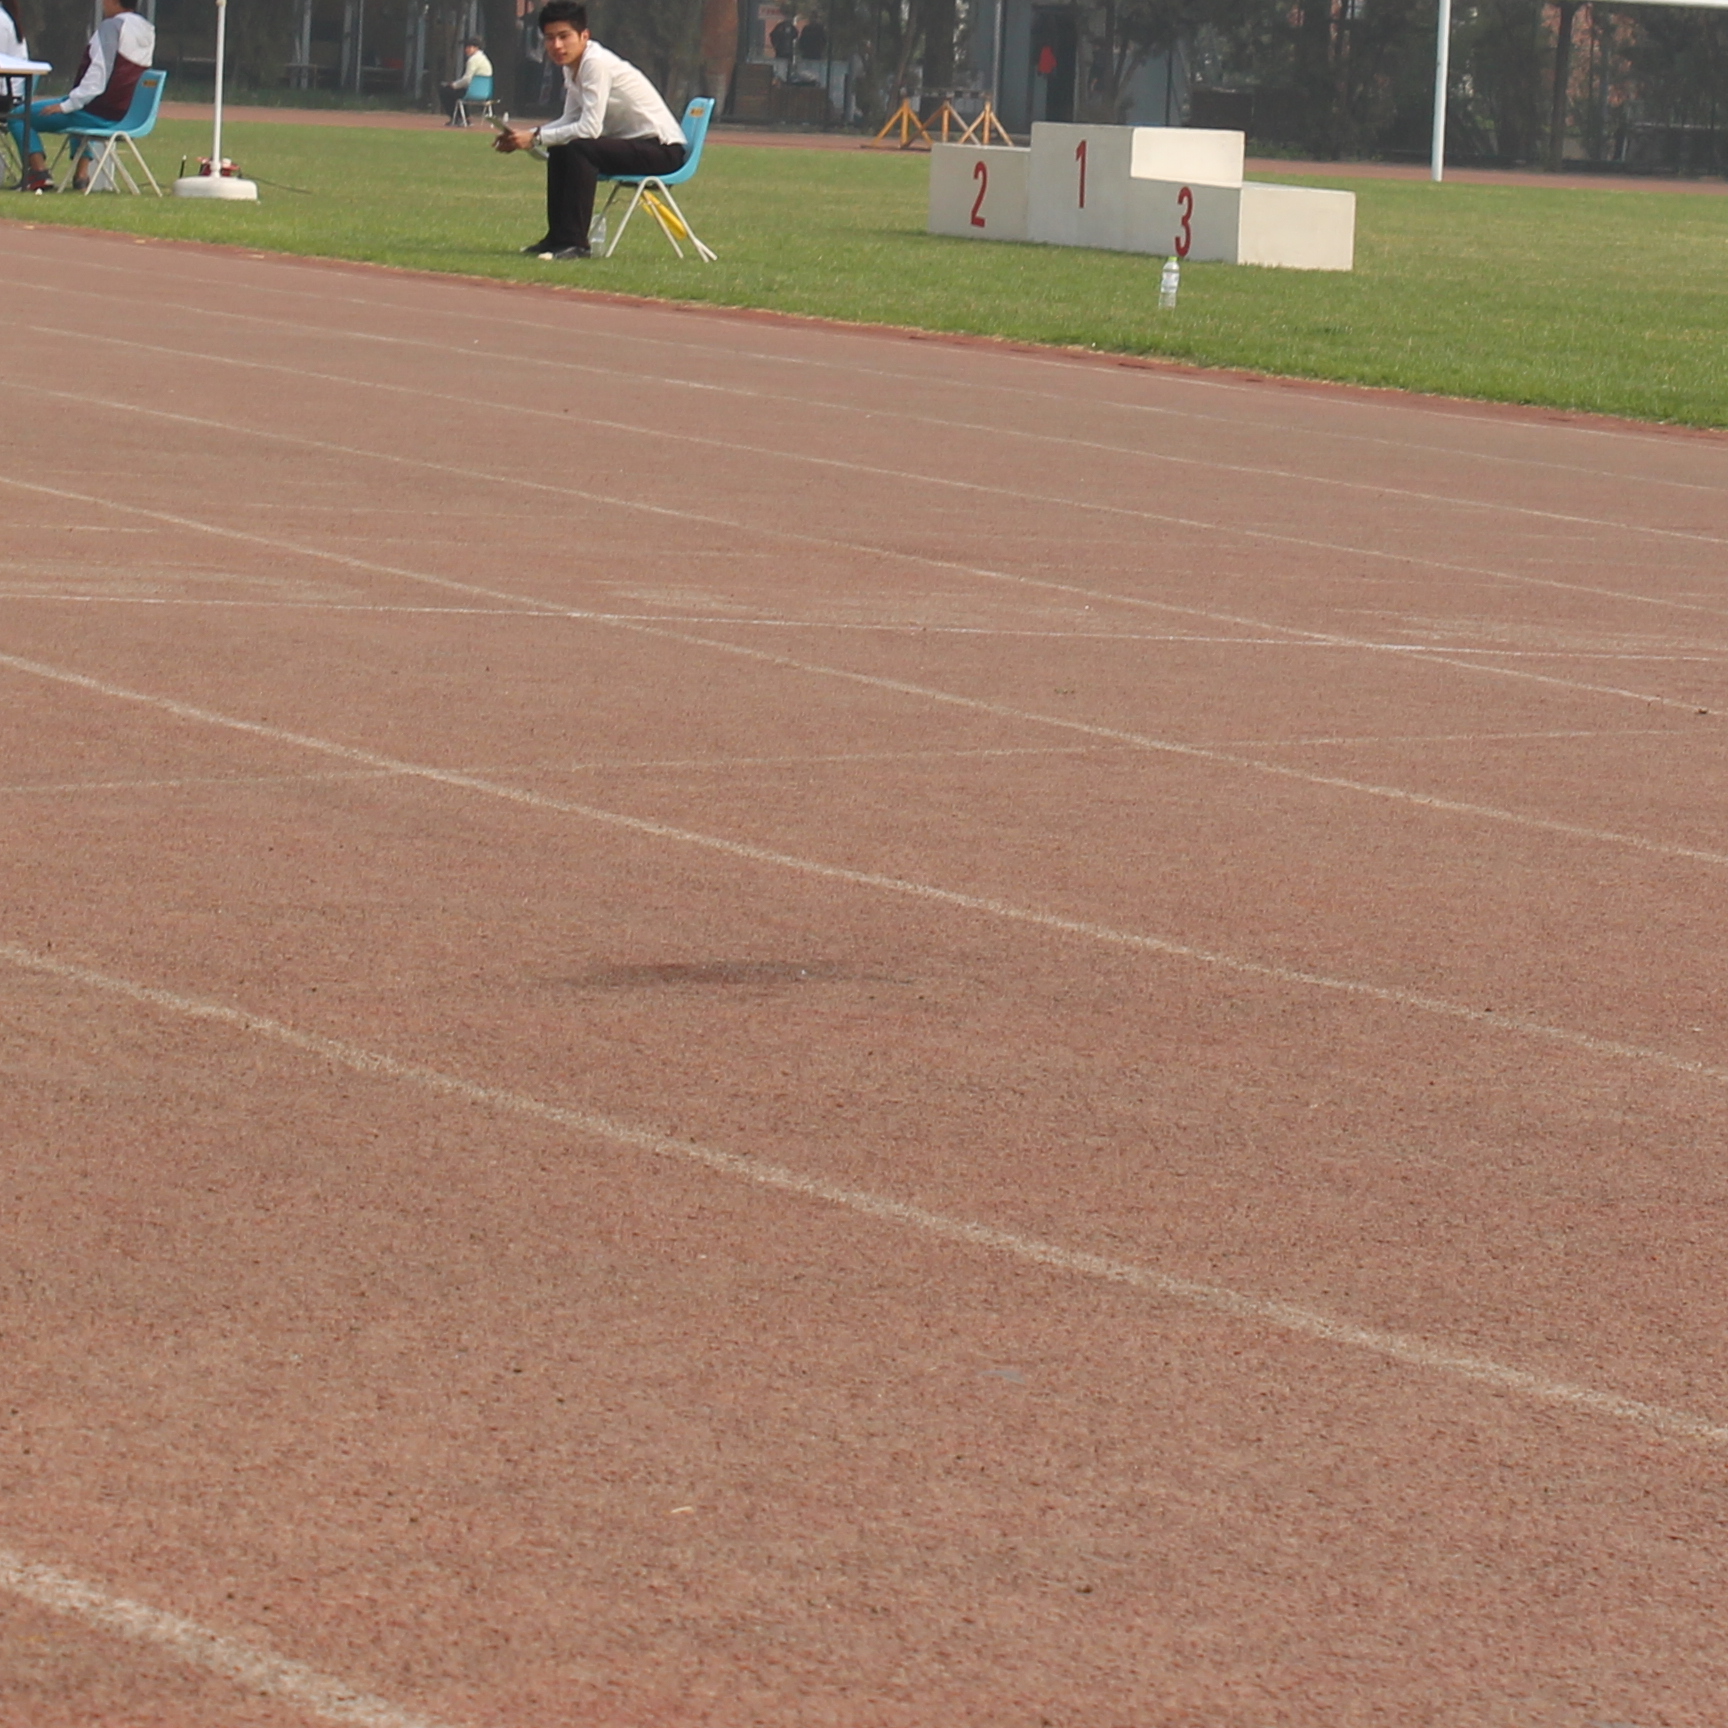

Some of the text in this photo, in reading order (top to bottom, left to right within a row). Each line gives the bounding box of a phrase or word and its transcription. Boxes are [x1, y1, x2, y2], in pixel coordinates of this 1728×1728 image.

[970, 161, 987, 228] 2
[1076, 140, 1087, 208] 1
[1175, 186, 1193, 257] 3
